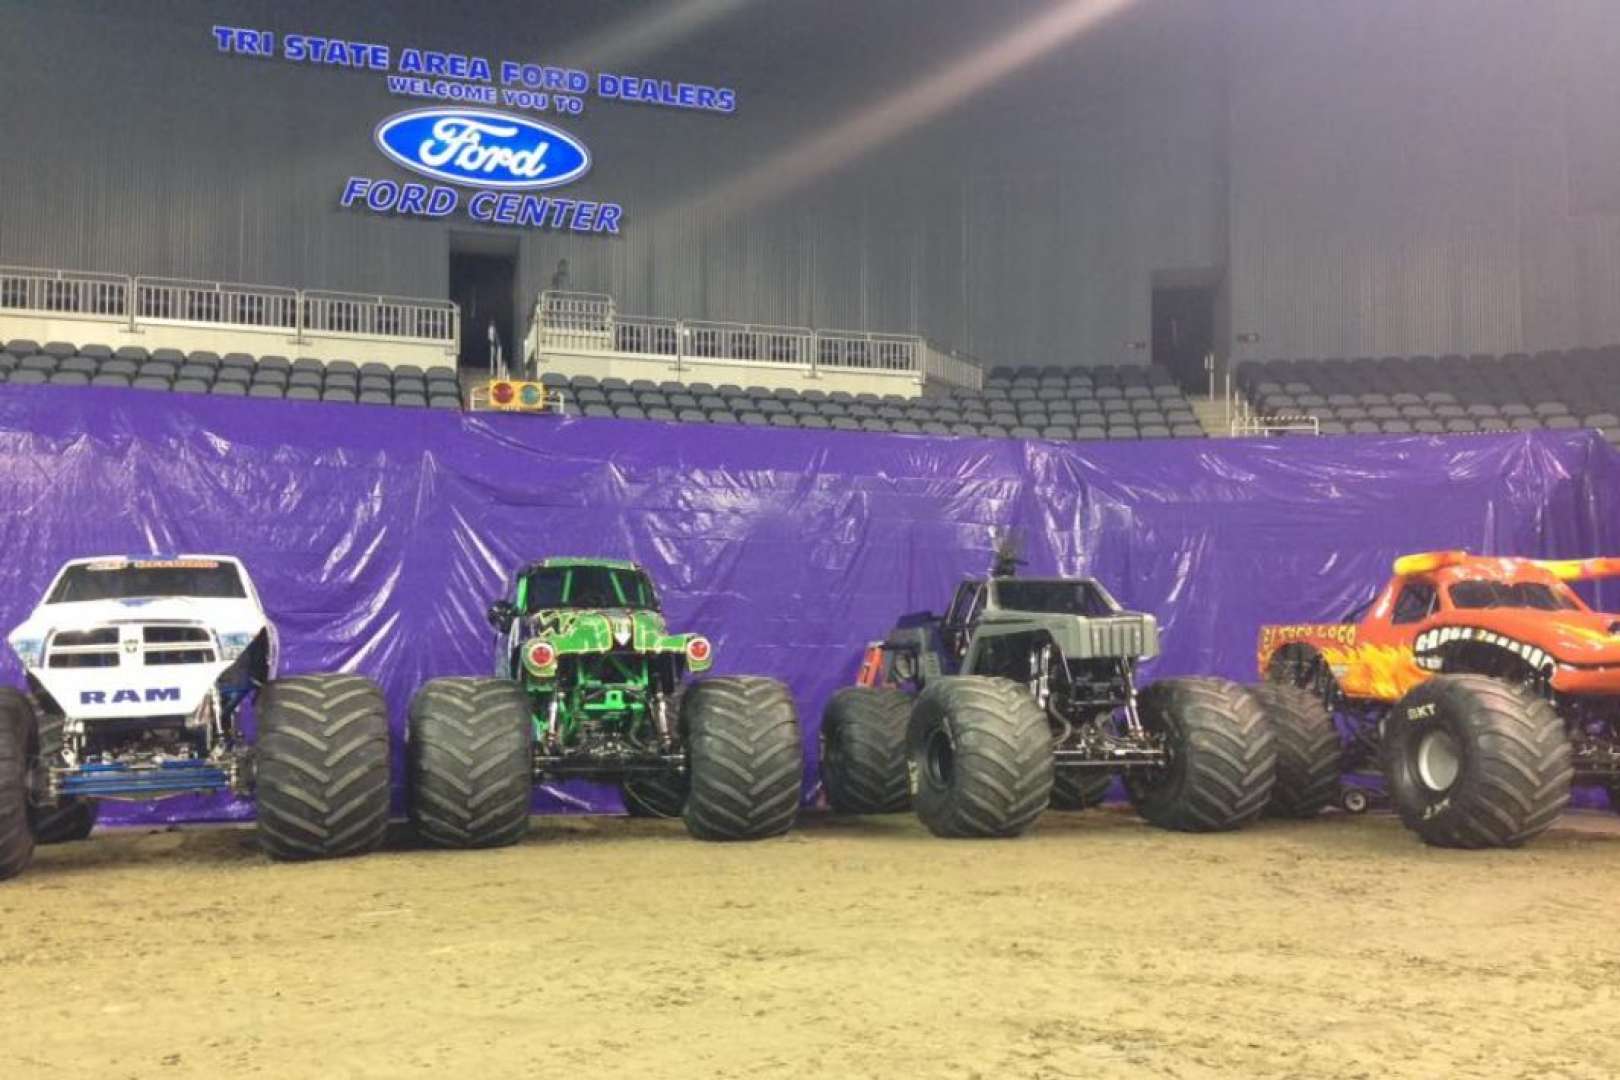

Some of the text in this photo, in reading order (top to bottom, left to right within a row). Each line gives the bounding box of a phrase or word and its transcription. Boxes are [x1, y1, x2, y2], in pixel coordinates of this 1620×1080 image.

[213, 25, 736, 112] TRI STATE AREA FORD DEALERS
[387, 75, 584, 115] WELCOME YOU TO
[418, 117, 550, 177] Ford
[341, 176, 622, 234] FORD CENTER
[80, 687, 181, 705] RAM
